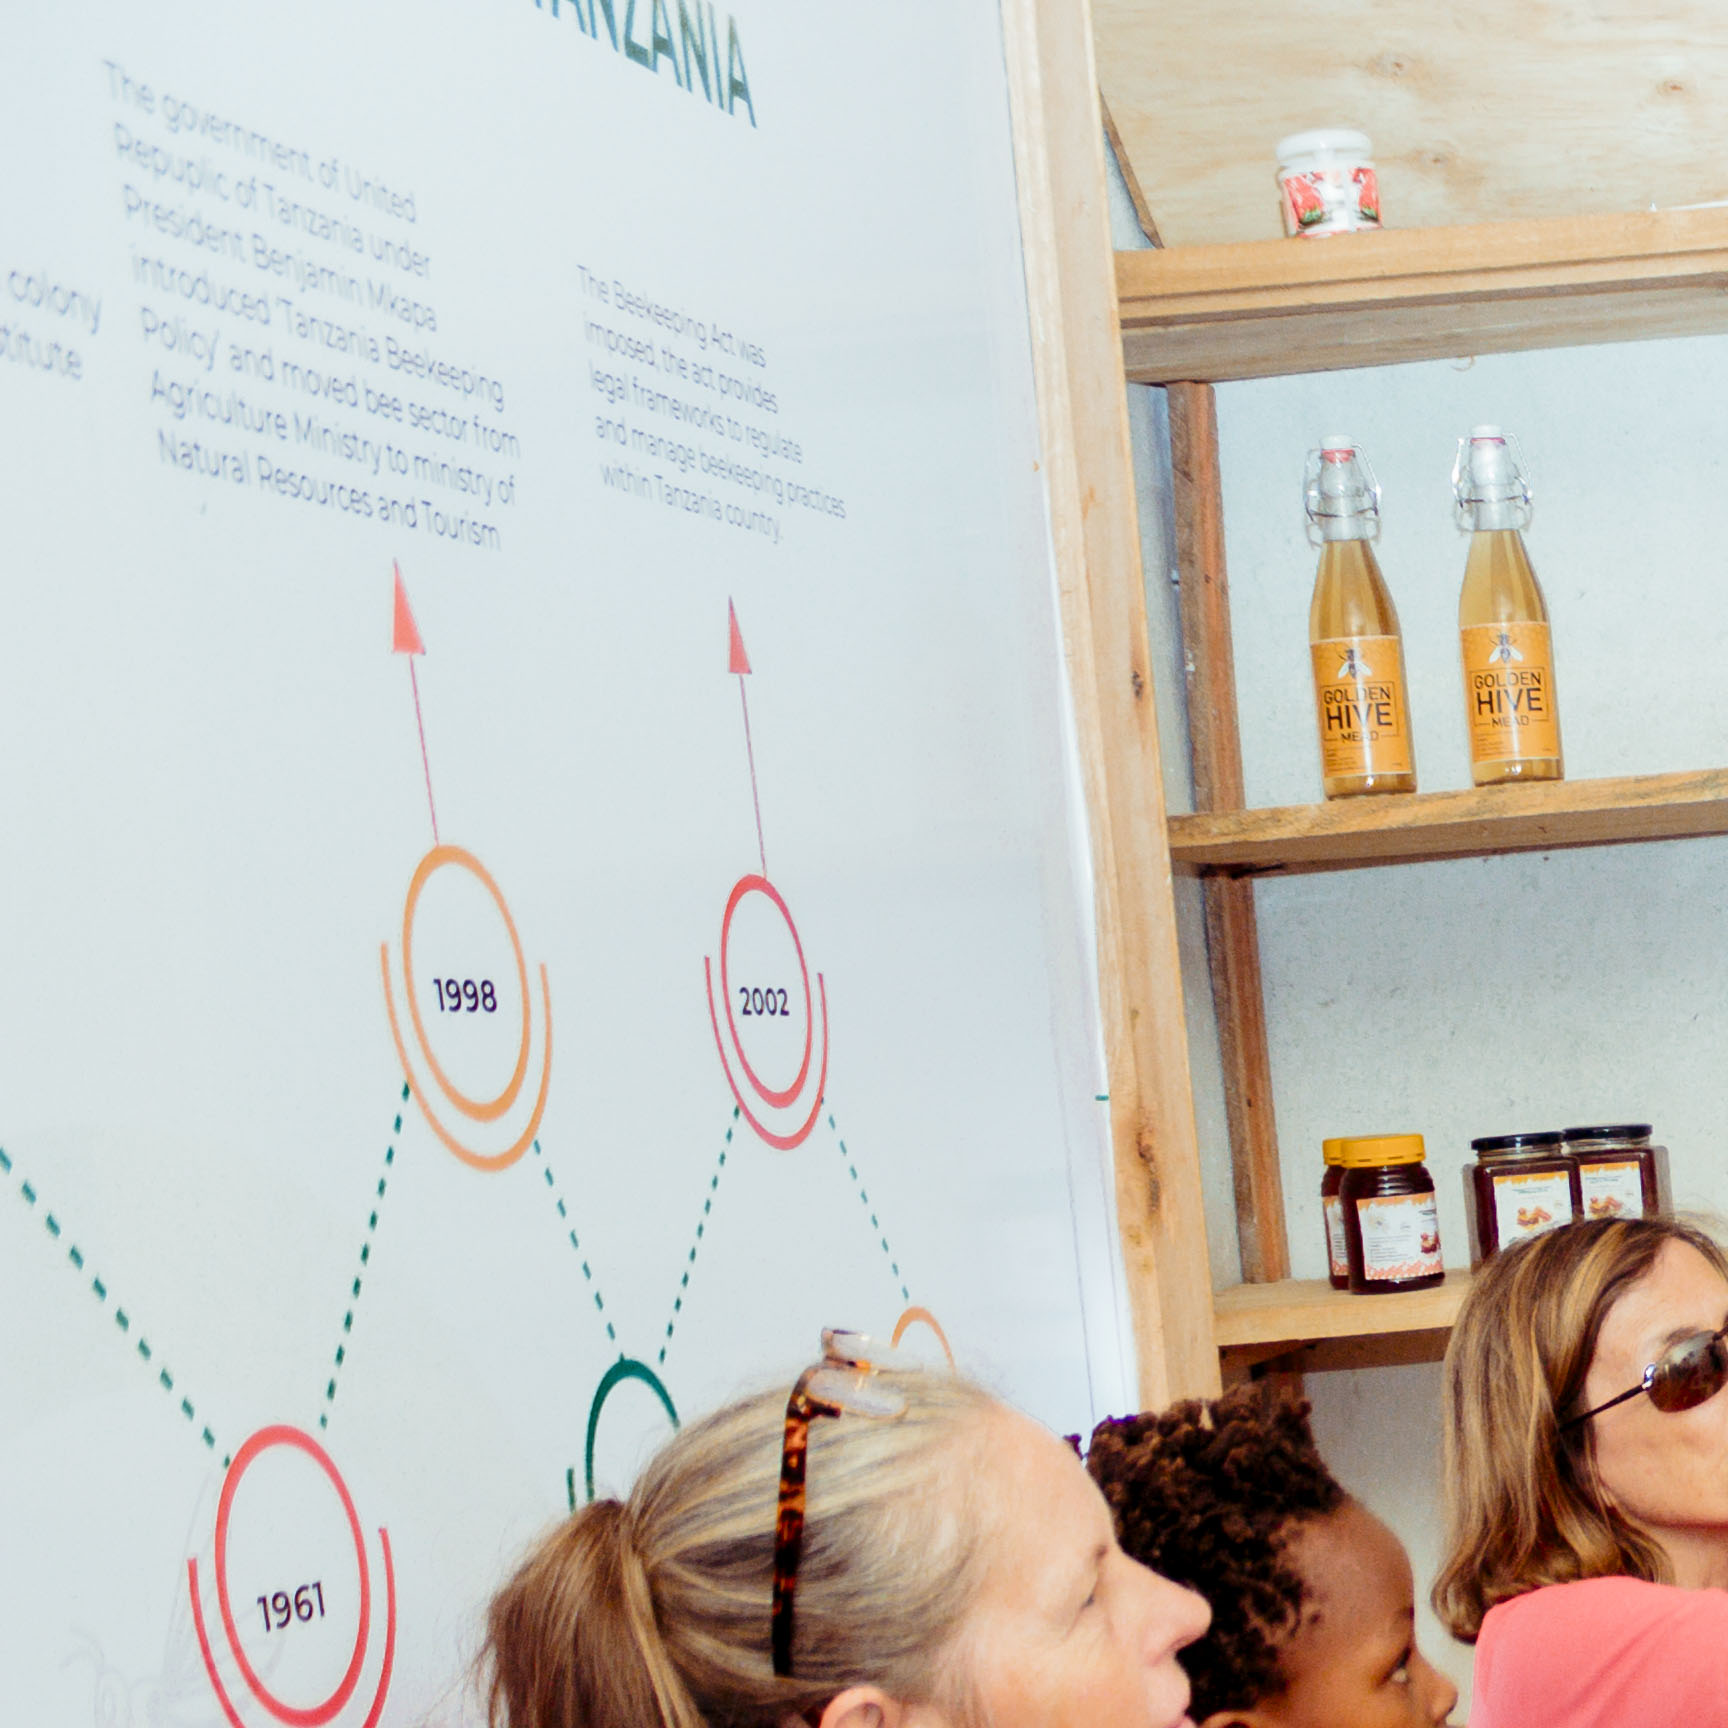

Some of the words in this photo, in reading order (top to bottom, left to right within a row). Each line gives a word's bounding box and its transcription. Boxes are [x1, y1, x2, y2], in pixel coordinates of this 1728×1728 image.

[534, 0, 758, 129] ZANIA
[101, 58, 155, 115] The
[162, 93, 314, 182] government
[320, 157, 339, 194] of
[344, 164, 417, 225] United
[122, 183, 246, 264] President
[251, 233, 364, 308] Benjamin
[365, 277, 437, 333] Mkapa
[235, 176, 257, 213] of
[262, 182, 364, 254] Tanzania
[367, 234, 432, 281] under
[7, 268, 102, 337] colony
[128, 241, 271, 327] introduced
[384, 335, 505, 414] Beekeeping
[576, 263, 610, 305] The
[612, 279, 708, 352] Beekeeping
[711, 322, 737, 357] Act
[739, 339, 767, 369] was
[228, 344, 275, 381] and
[280, 360, 359, 408] moved
[363, 378, 402, 423] bee
[408, 401, 469, 441] sector
[472, 414, 521, 459] from
[588, 357, 631, 405] legal
[632, 375, 726, 437] frameworks
[726, 415, 744, 442] to
[745, 424, 803, 465] regulate
[661, 345, 689, 380] the
[692, 361, 717, 391] act
[718, 372, 779, 415] provides
[150, 369, 288, 441] Agriculture
[292, 411, 381, 476] Ministry
[385, 443, 409, 476] to
[412, 452, 494, 508] ministry
[497, 474, 517, 506] of
[595, 415, 628, 447] and
[630, 427, 697, 474] manage
[698, 443, 785, 506] beekeeping
[787, 480, 848, 520] practices
[156, 427, 251, 485] Natural
[256, 453, 374, 519] Resources
[378, 495, 418, 529] and
[420, 499, 502, 552] Tourism
[600, 459, 654, 503] within
[653, 473, 723, 522] Tanzania
[725, 502, 785, 546] country.
[1323, 685, 1391, 705] GOLDEN
[1325, 702, 1393, 731] HIVE
[1473, 672, 1542, 689] GOLDEN
[1475, 687, 1543, 716] HIVE
[1340, 730, 1380, 743] MED
[433, 976, 499, 1015] 1998
[737, 986, 791, 1019] 2002
[256, 1579, 327, 1634] 1961
